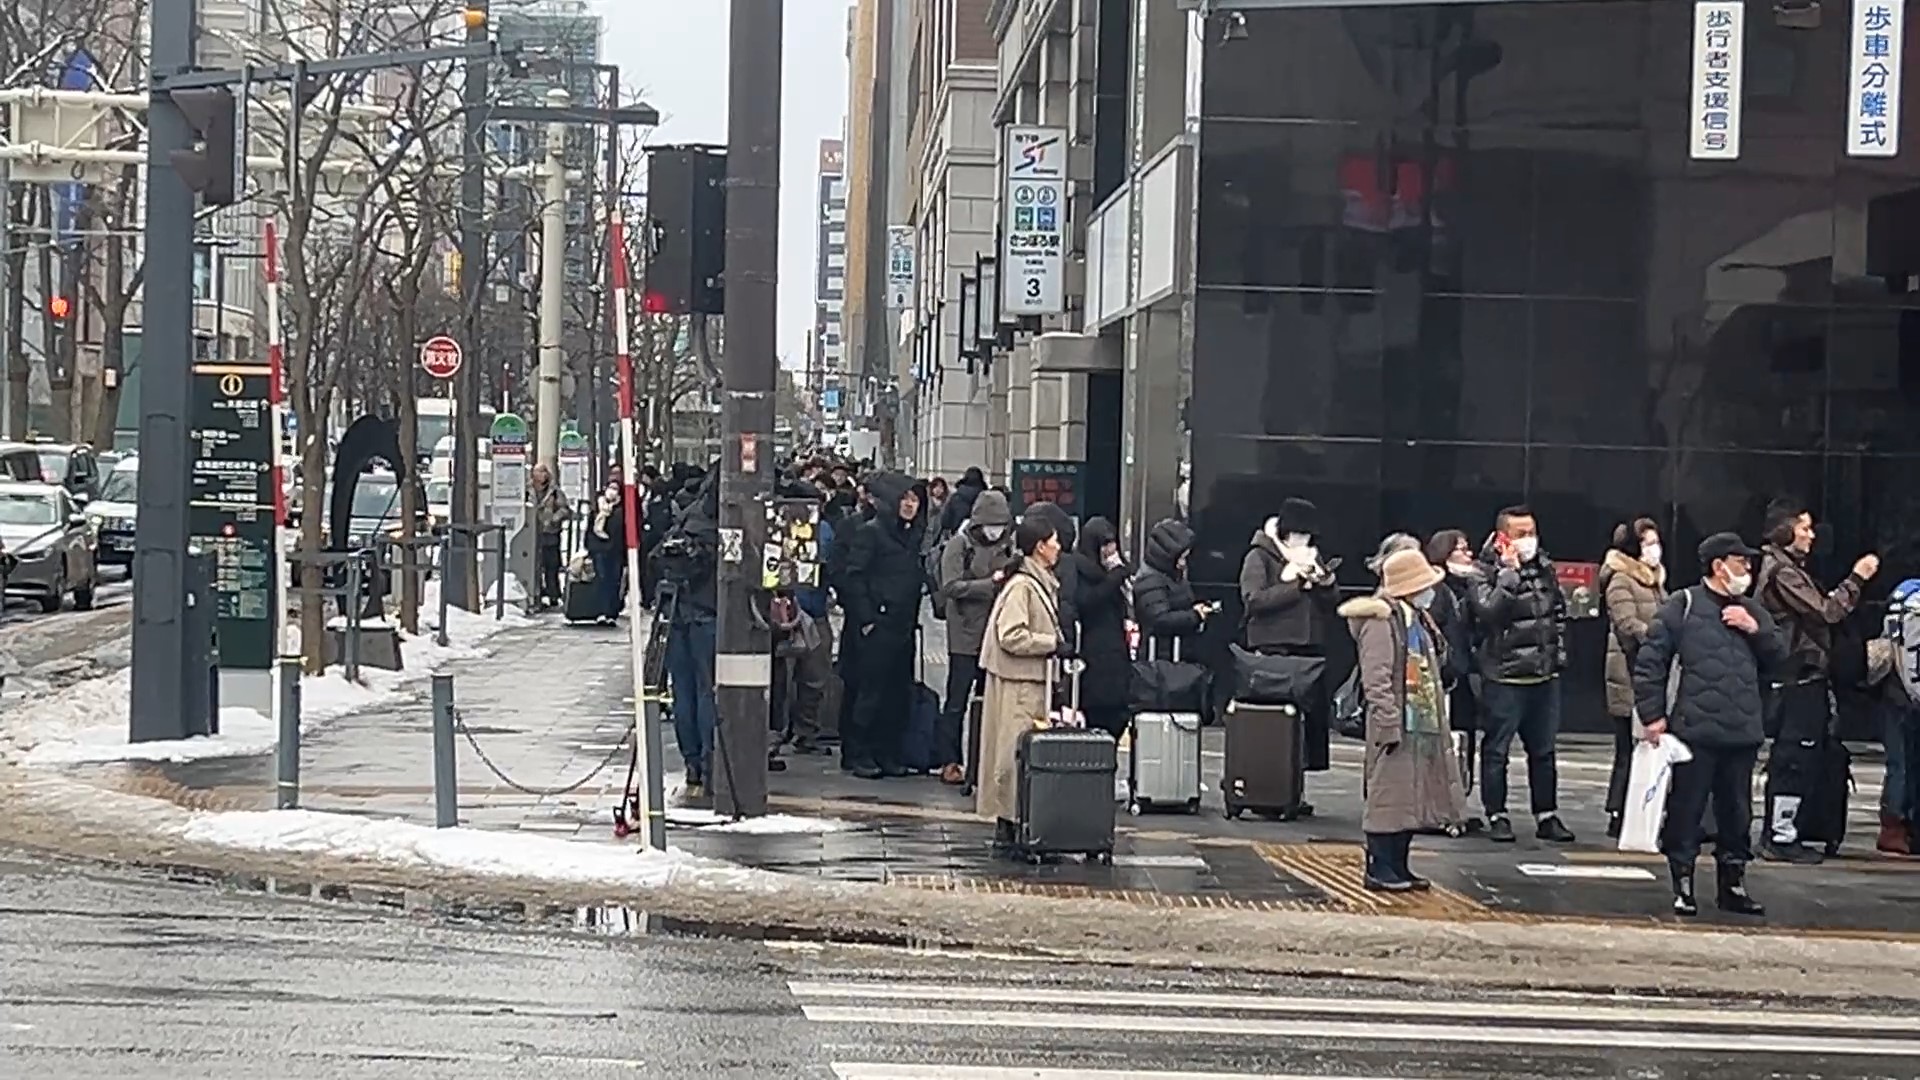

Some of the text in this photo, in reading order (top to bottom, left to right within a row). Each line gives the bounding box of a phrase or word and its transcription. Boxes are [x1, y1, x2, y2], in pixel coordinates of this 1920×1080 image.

[1701, 10, 1732, 151] 歩行者支援信号
[1860, 5, 1893, 147] 歩車分離式
[1009, 233, 1060, 248] さっぽろ駅
[1026, 278, 1041, 298] 3
